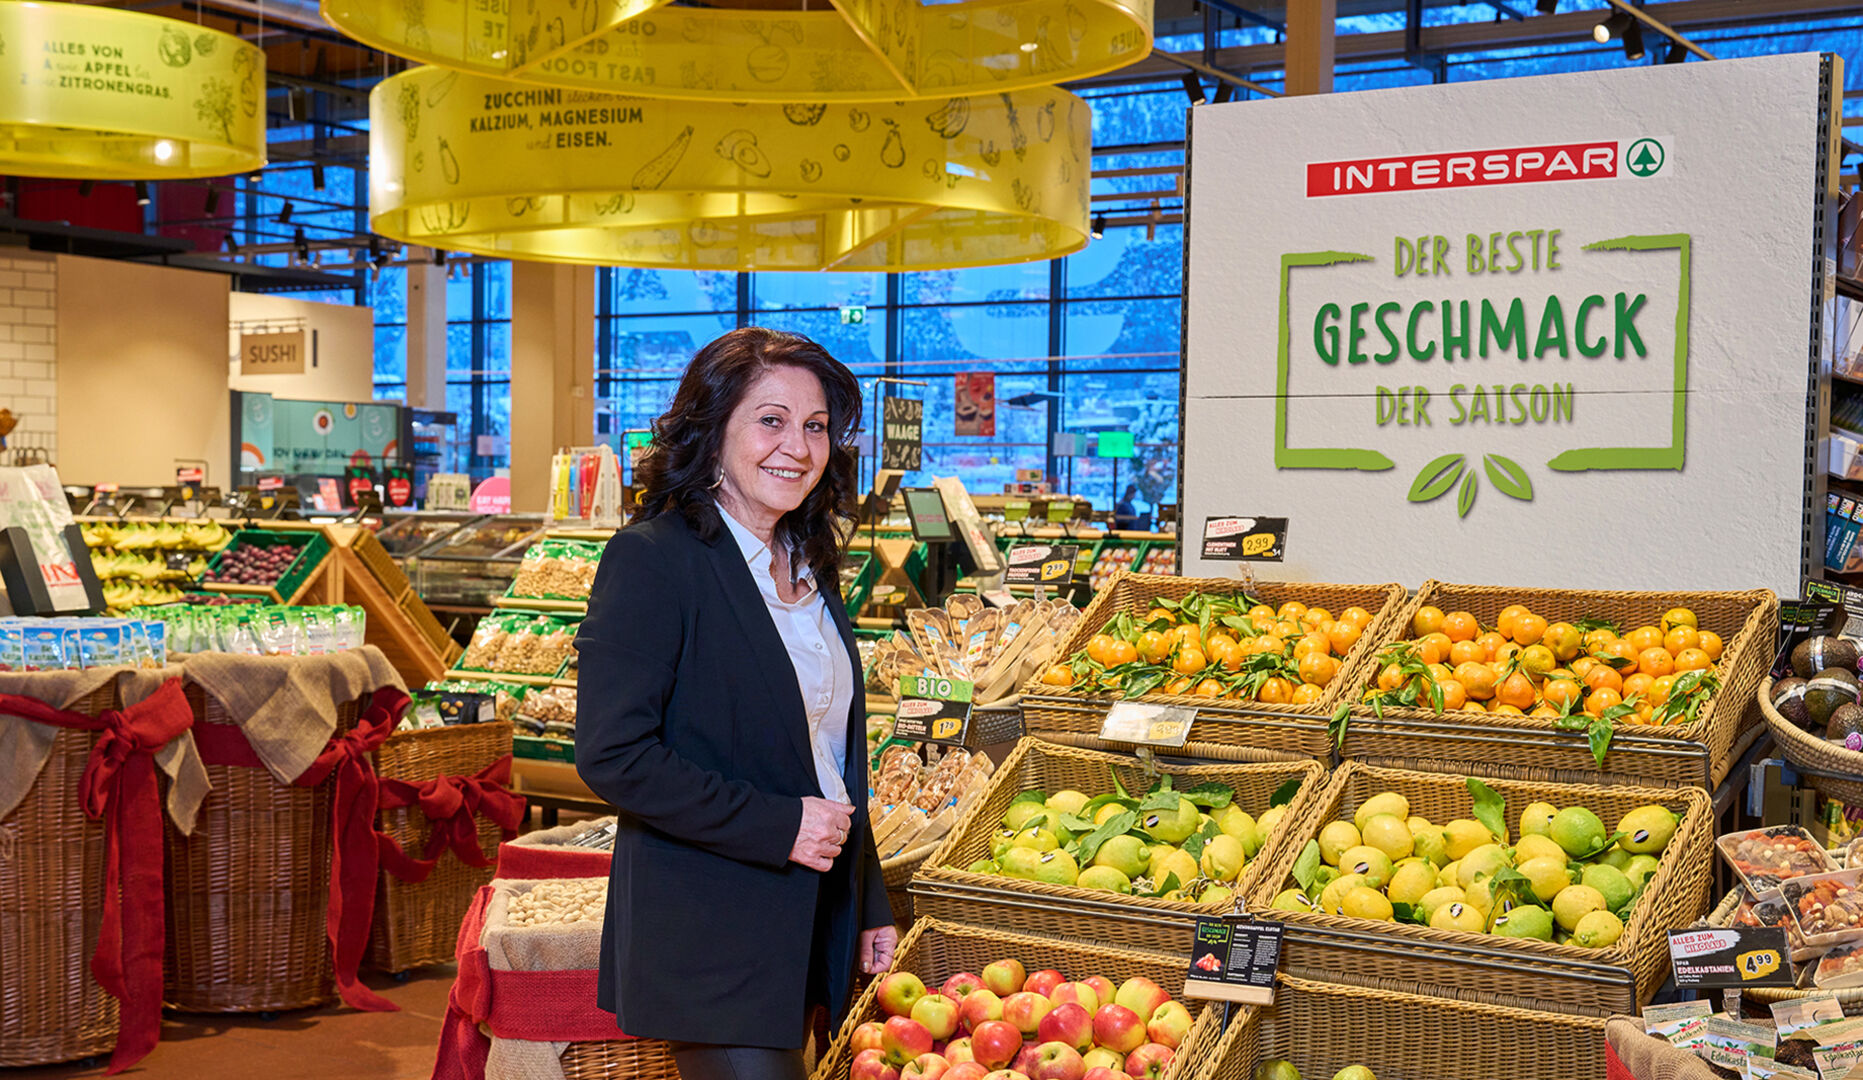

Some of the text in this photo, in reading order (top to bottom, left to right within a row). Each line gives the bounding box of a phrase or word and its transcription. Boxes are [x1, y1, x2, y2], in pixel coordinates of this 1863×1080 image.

[44, 41, 124, 59] ALLES VON
[85, 61, 132, 78] APFEL
[60, 76, 173, 100] ZITRONENGRAS.
[484, 88, 562, 110] ZUCCHINI
[470, 107, 643, 133] KALZIUM, MAGNESIUM
[556, 131, 612, 148] EISEN.
[1333, 147, 1615, 191] INTERSPAR
[1394, 229, 1562, 277] DER BESTE
[1313, 291, 1648, 365] GESCHMACK
[249, 344, 296, 364] SUSHI
[1376, 382, 1573, 425] DER SAISON
[887, 424, 920, 440] WAAGE
[1246, 537, 1269, 552] 2,99
[917, 677, 951, 697] BIO
[1672, 932, 1714, 945] ALLES ZUM
[1684, 938, 1727, 953] NIKOLAUS
[1677, 965, 1735, 974] EDELKASTANIEN
